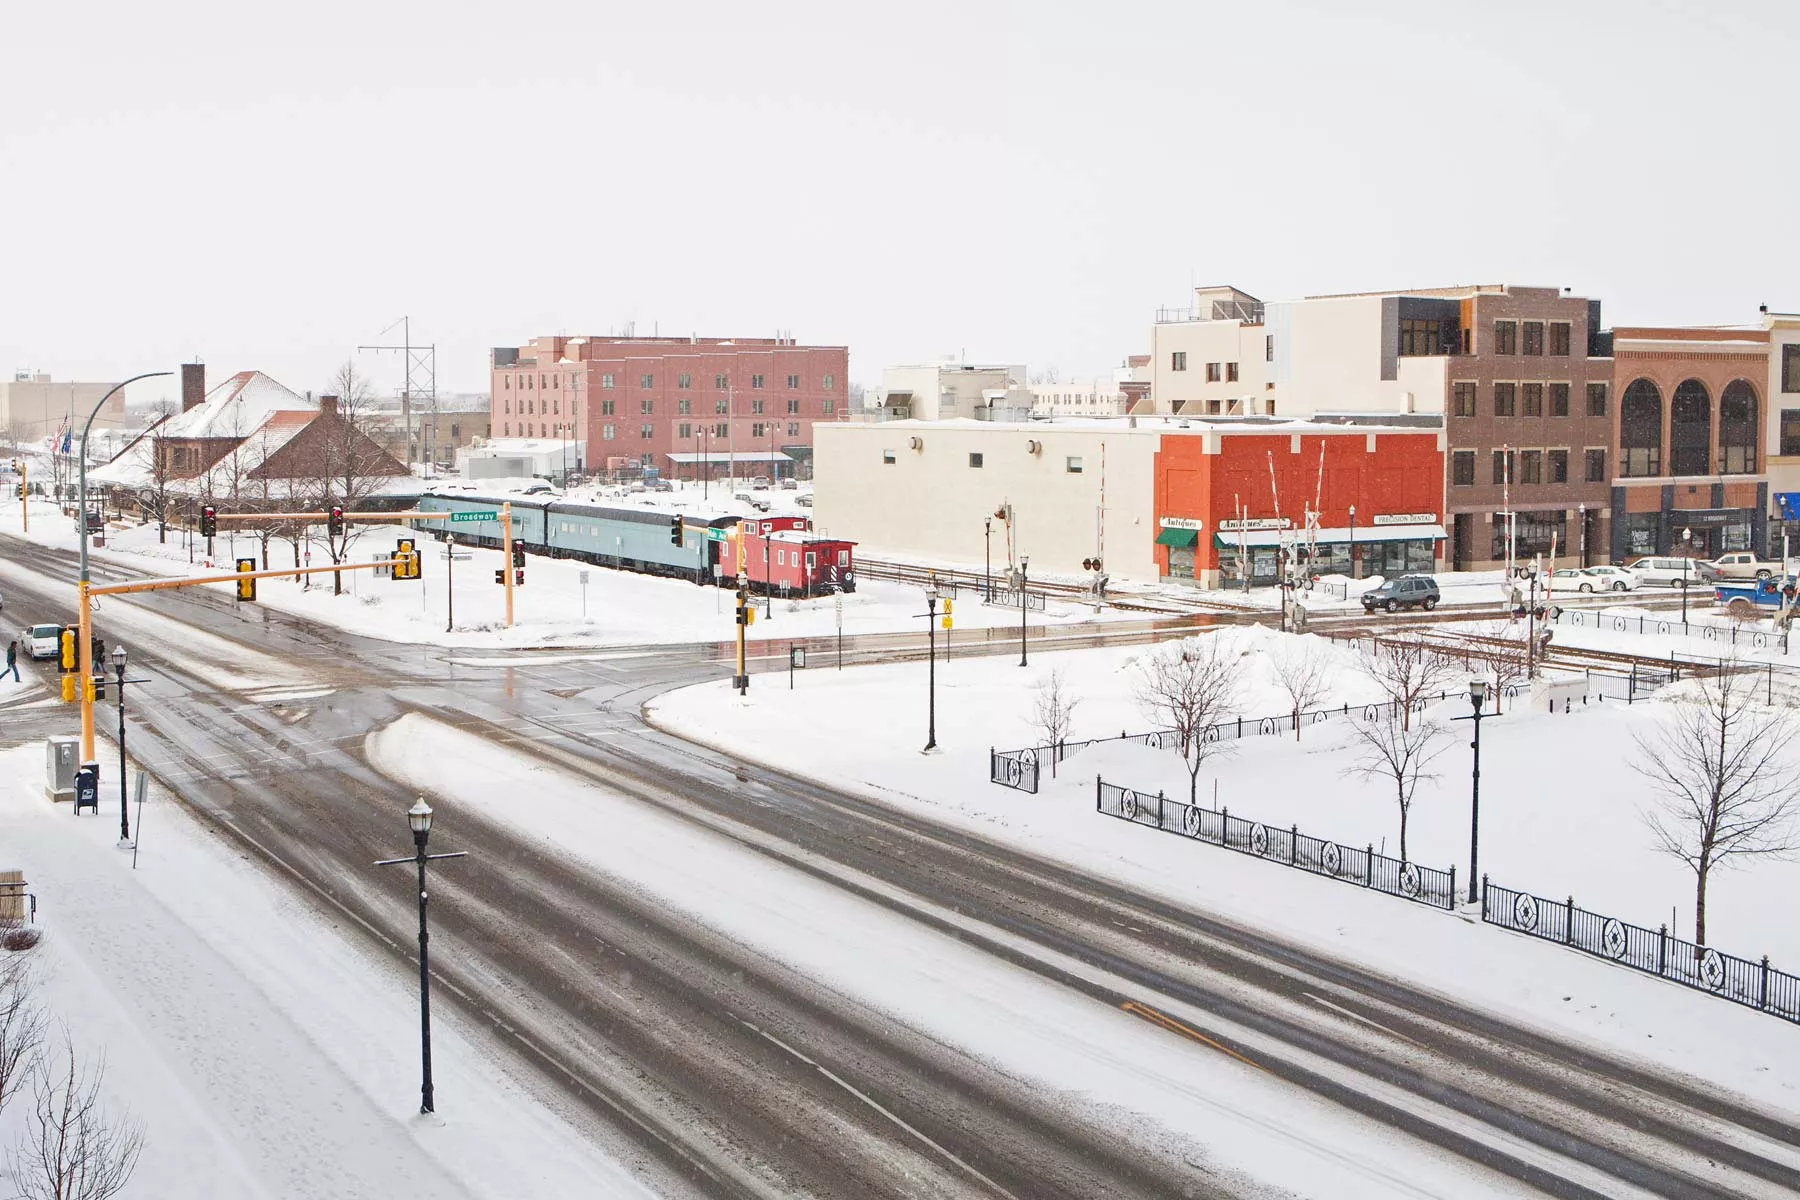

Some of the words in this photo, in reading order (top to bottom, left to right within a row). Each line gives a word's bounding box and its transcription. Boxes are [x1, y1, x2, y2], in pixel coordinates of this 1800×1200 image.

[453, 513, 494, 521] Broadway
[1379, 515, 1408, 523] PRECISION
[1165, 518, 1197, 528] Antiques
